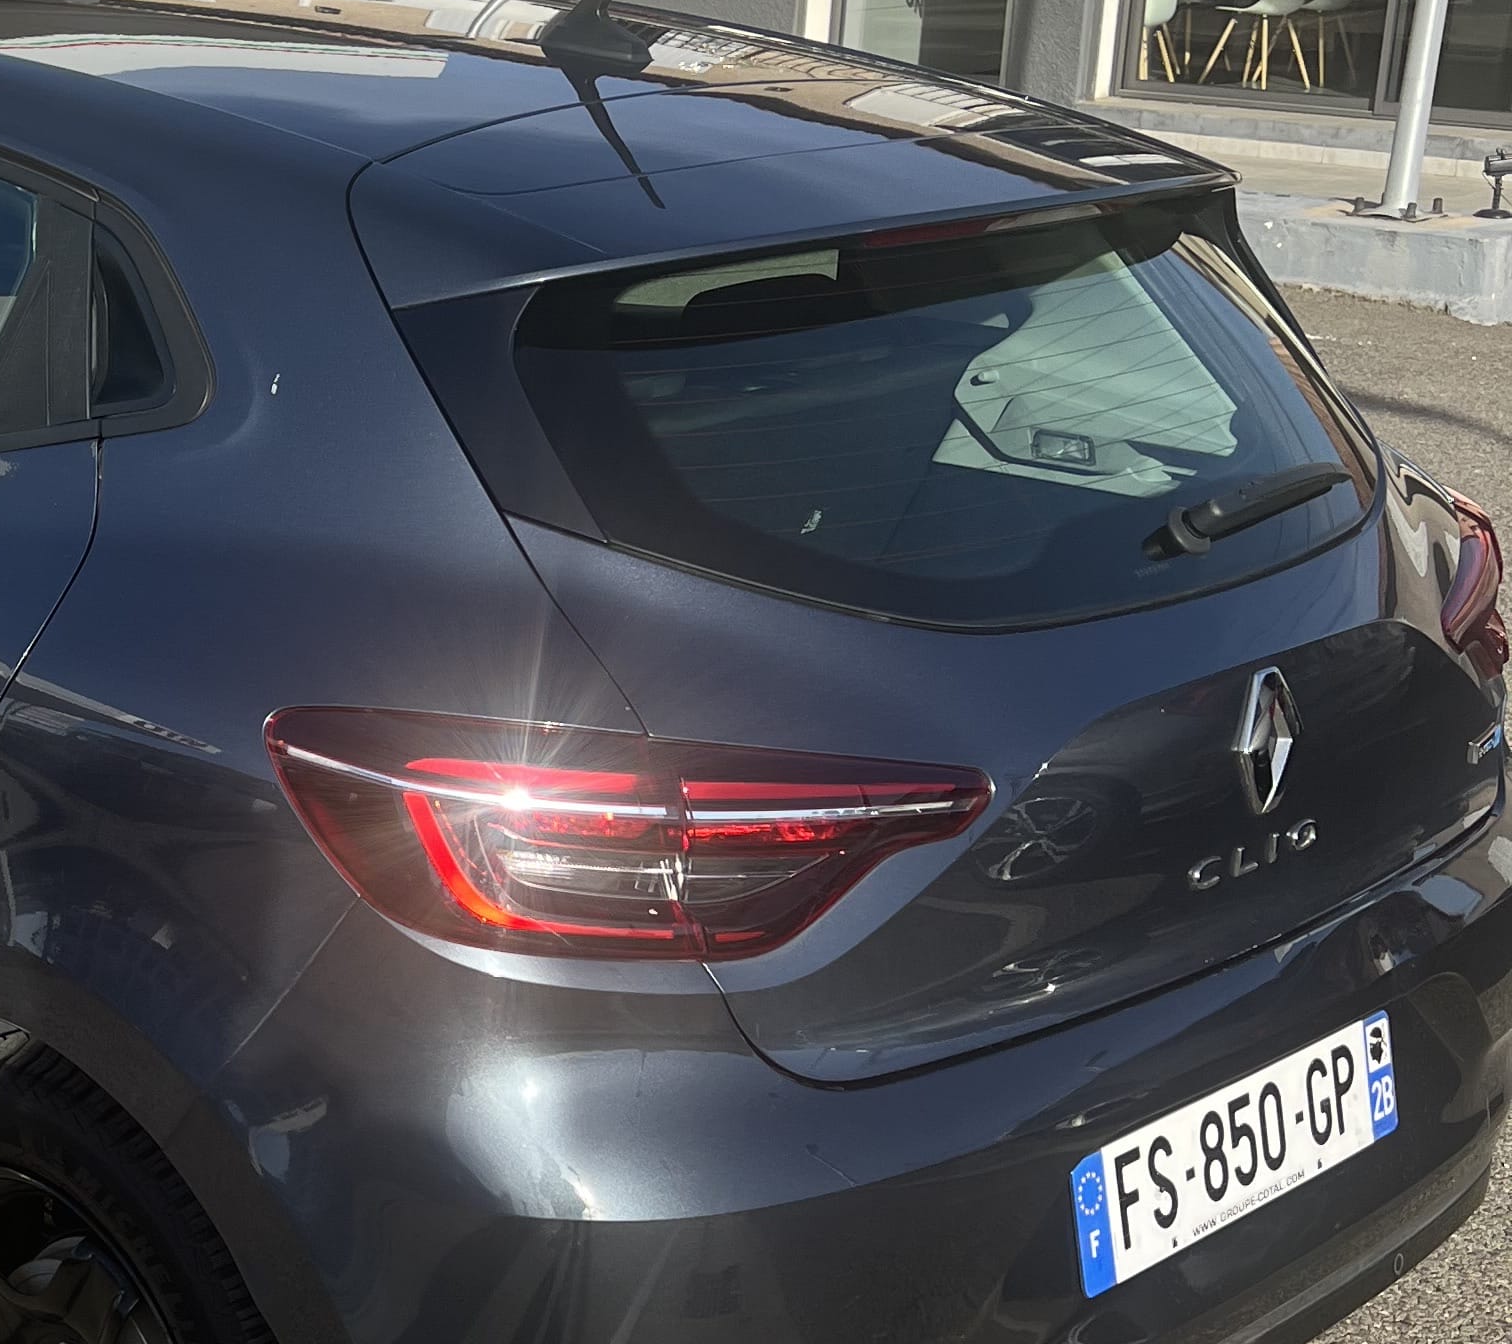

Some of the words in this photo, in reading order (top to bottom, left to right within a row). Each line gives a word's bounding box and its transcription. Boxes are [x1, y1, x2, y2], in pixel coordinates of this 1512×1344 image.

[1187, 818, 1318, 890] CLIO
[1371, 1074, 1395, 1123] 2B
[1114, 1044, 1355, 1251] FS-850-GP
[1089, 1229, 1101, 1259] F
